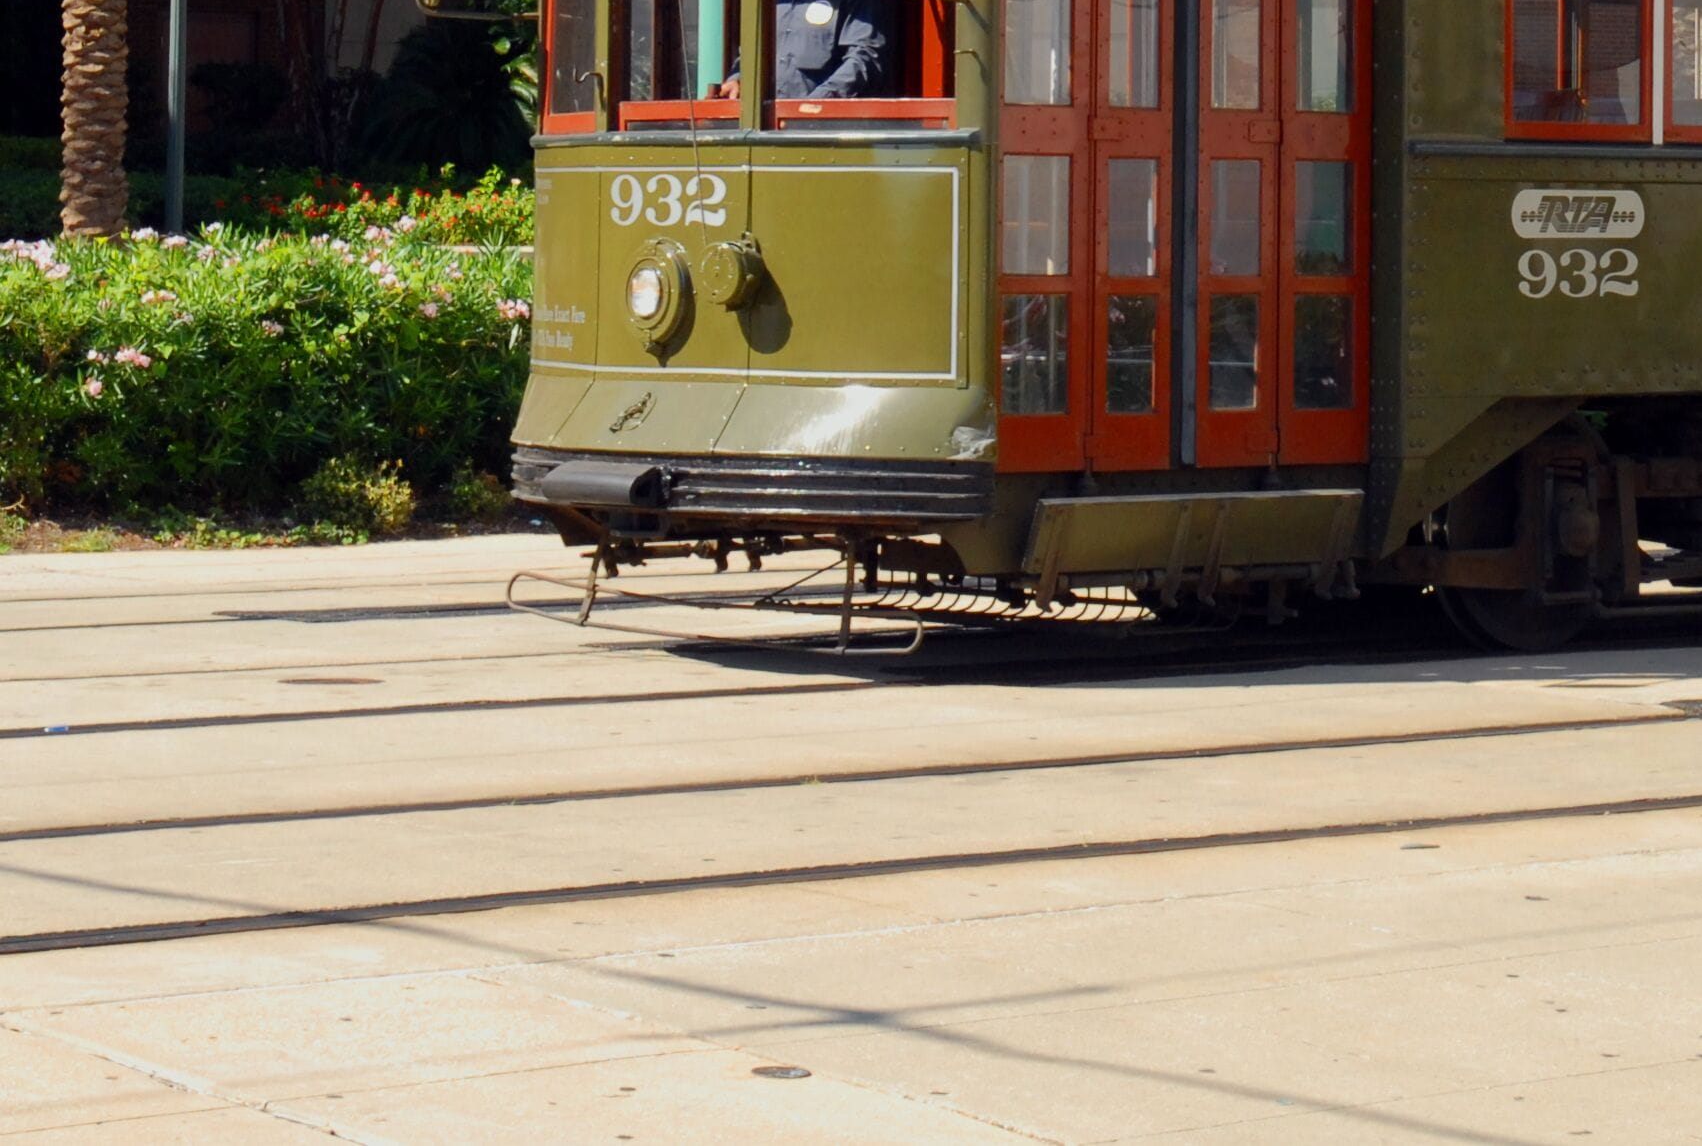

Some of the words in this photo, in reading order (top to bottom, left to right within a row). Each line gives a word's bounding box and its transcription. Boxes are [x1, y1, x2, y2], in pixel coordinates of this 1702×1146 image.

[609, 172, 727, 228] 932
[1539, 195, 1617, 233] RTA
[1517, 248, 1640, 299] 932
